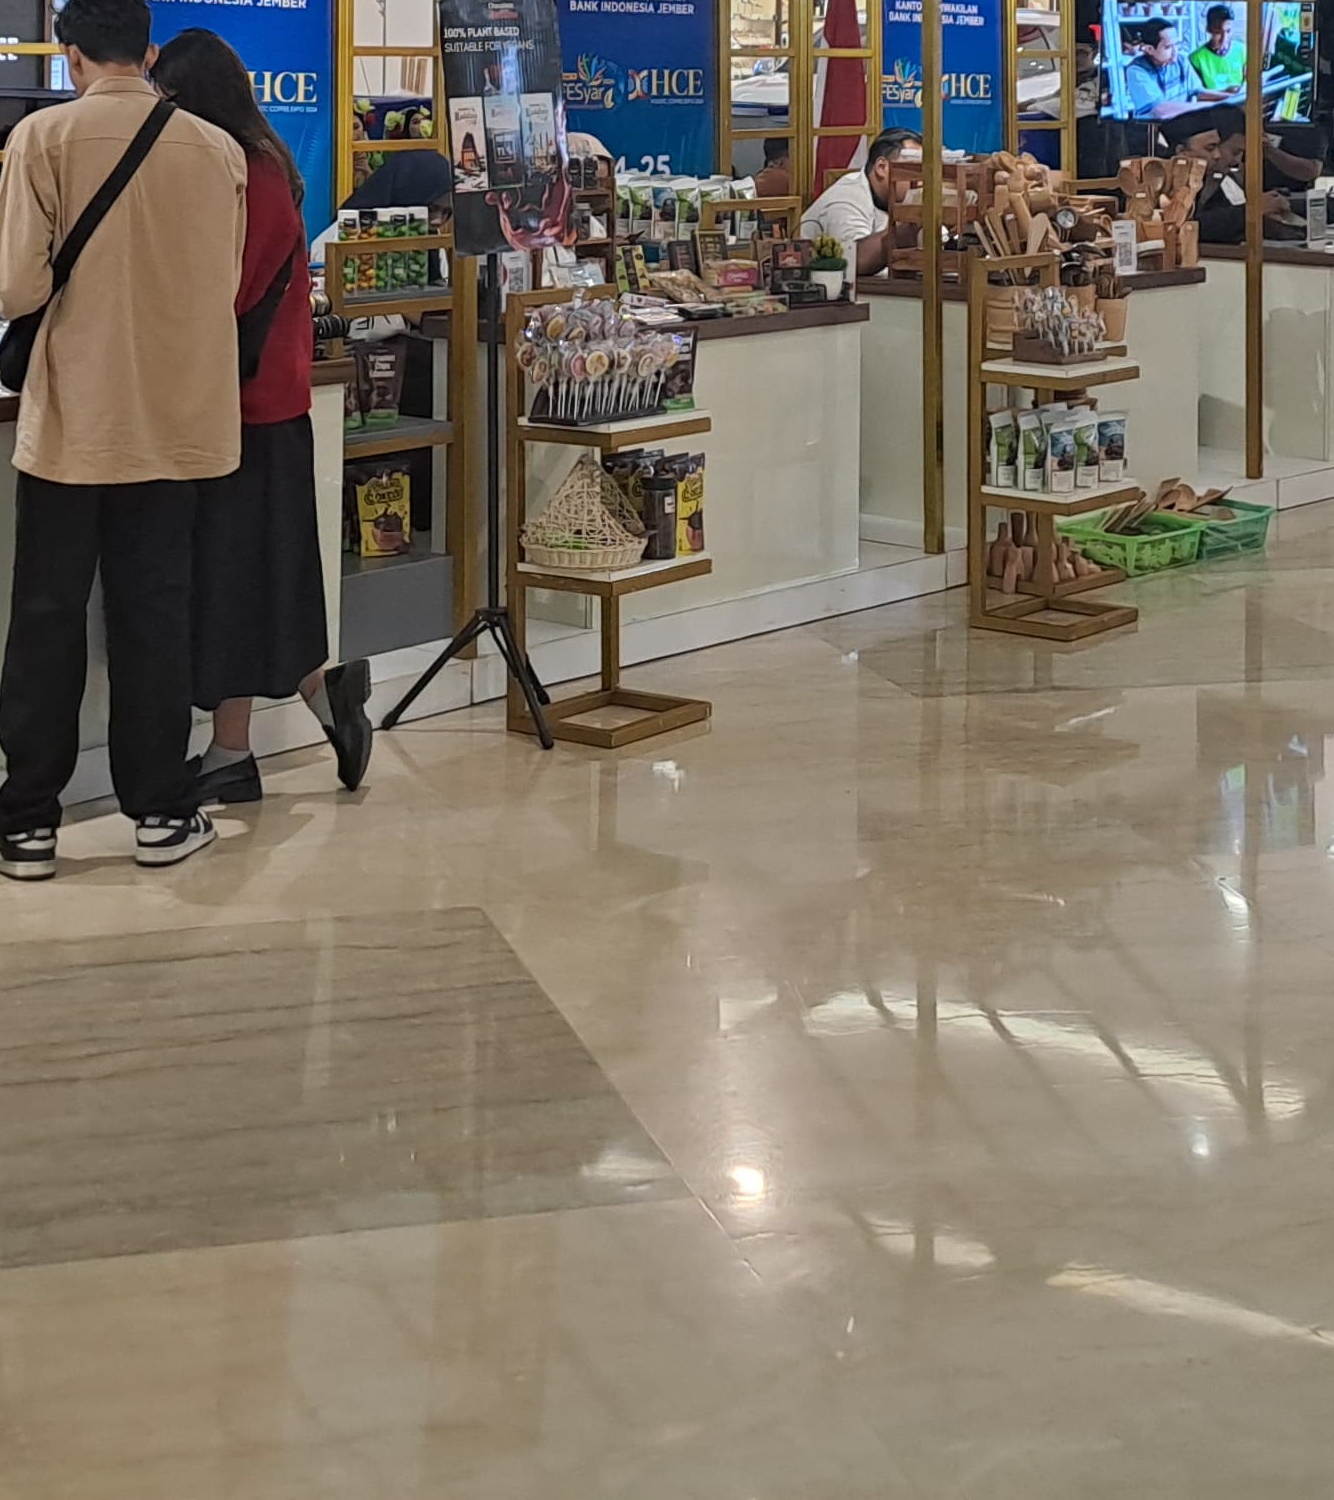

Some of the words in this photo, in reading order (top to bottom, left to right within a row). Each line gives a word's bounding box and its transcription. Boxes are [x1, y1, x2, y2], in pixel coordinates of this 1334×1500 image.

[569, 0, 599, 13] BANK
[600, 1, 654, 14] INDONESIA
[657, 3, 695, 15] JEMBER
[895, 0, 922, 13] KANTO
[941, 2, 979, 15] WAKILAN
[249, 71, 318, 104] HCE
[650, 68, 704, 97] HCE
[951, 73, 992, 99] HCE
